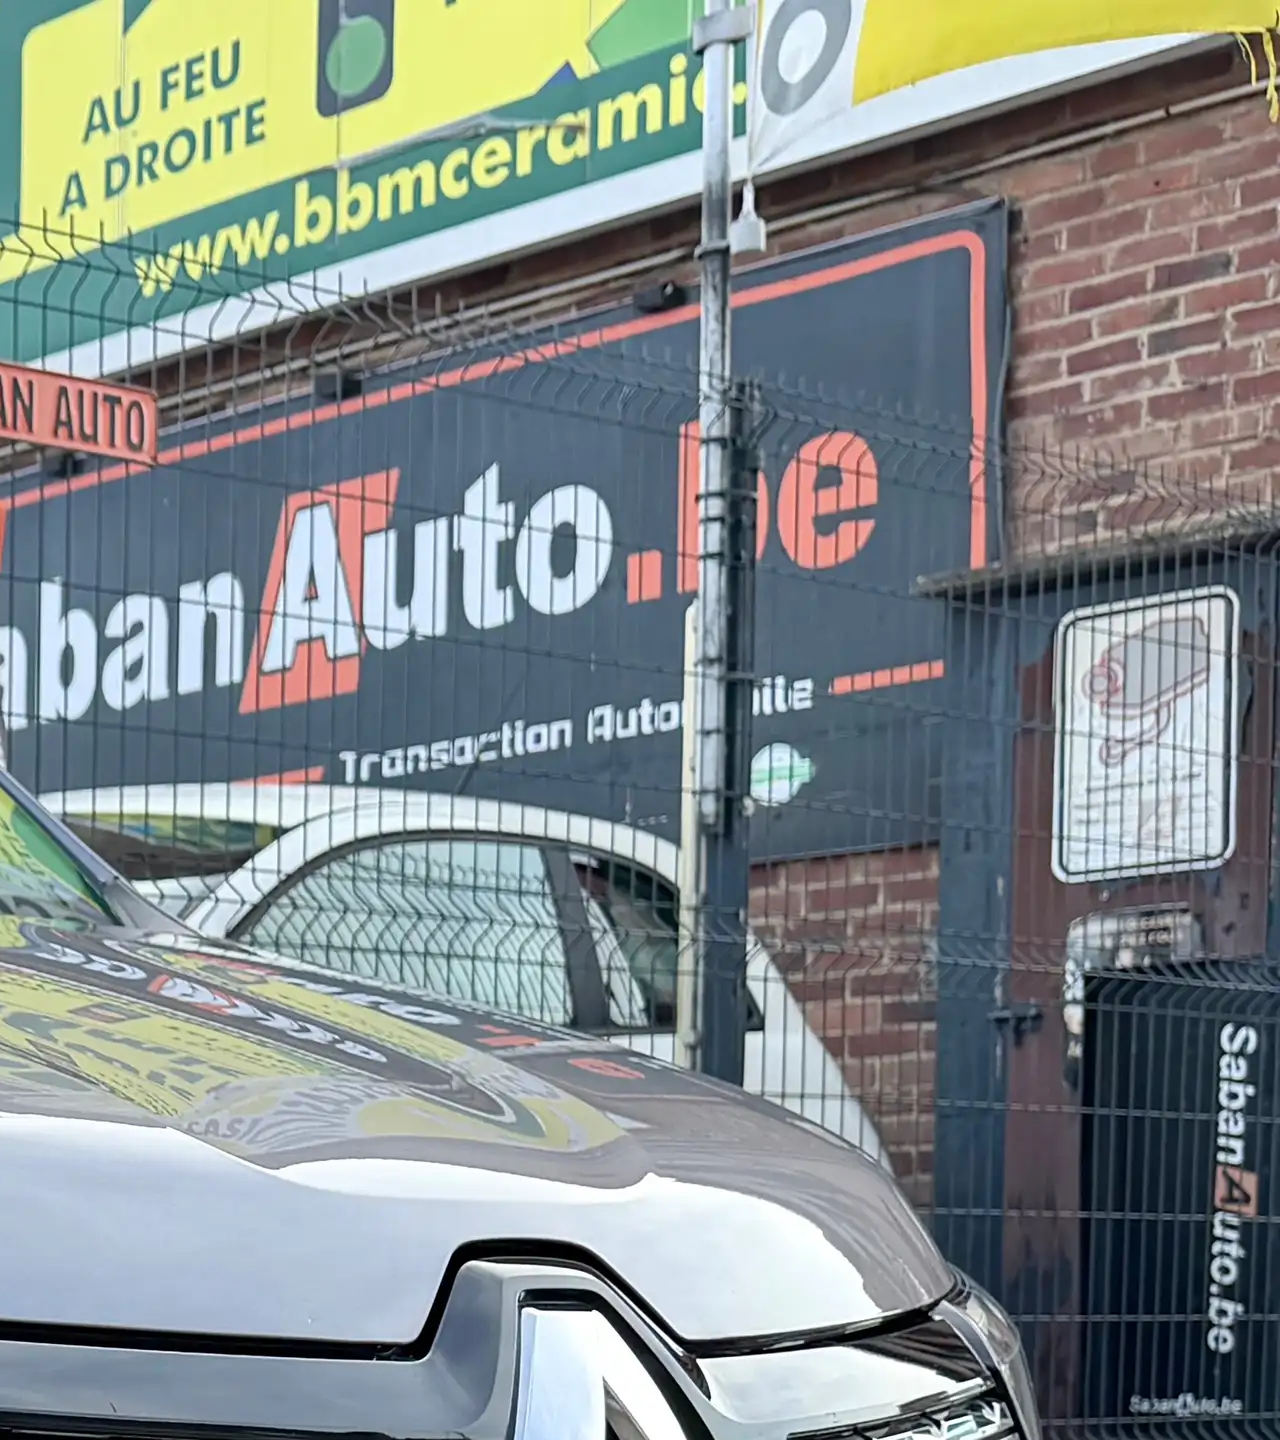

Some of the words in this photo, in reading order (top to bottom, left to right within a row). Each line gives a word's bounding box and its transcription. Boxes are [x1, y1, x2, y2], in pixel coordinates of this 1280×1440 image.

[82, 78, 140, 145] AU
[161, 37, 240, 112] FEU
[60, 170, 87, 218] A
[105, 97, 266, 200] DROITE
[54, 385, 144, 451] AUTO
[339, 719, 573, 784] Transaction
[588, 673, 814, 733] Autoile
[1207, 1022, 1258, 1354] SabanAuto.be
